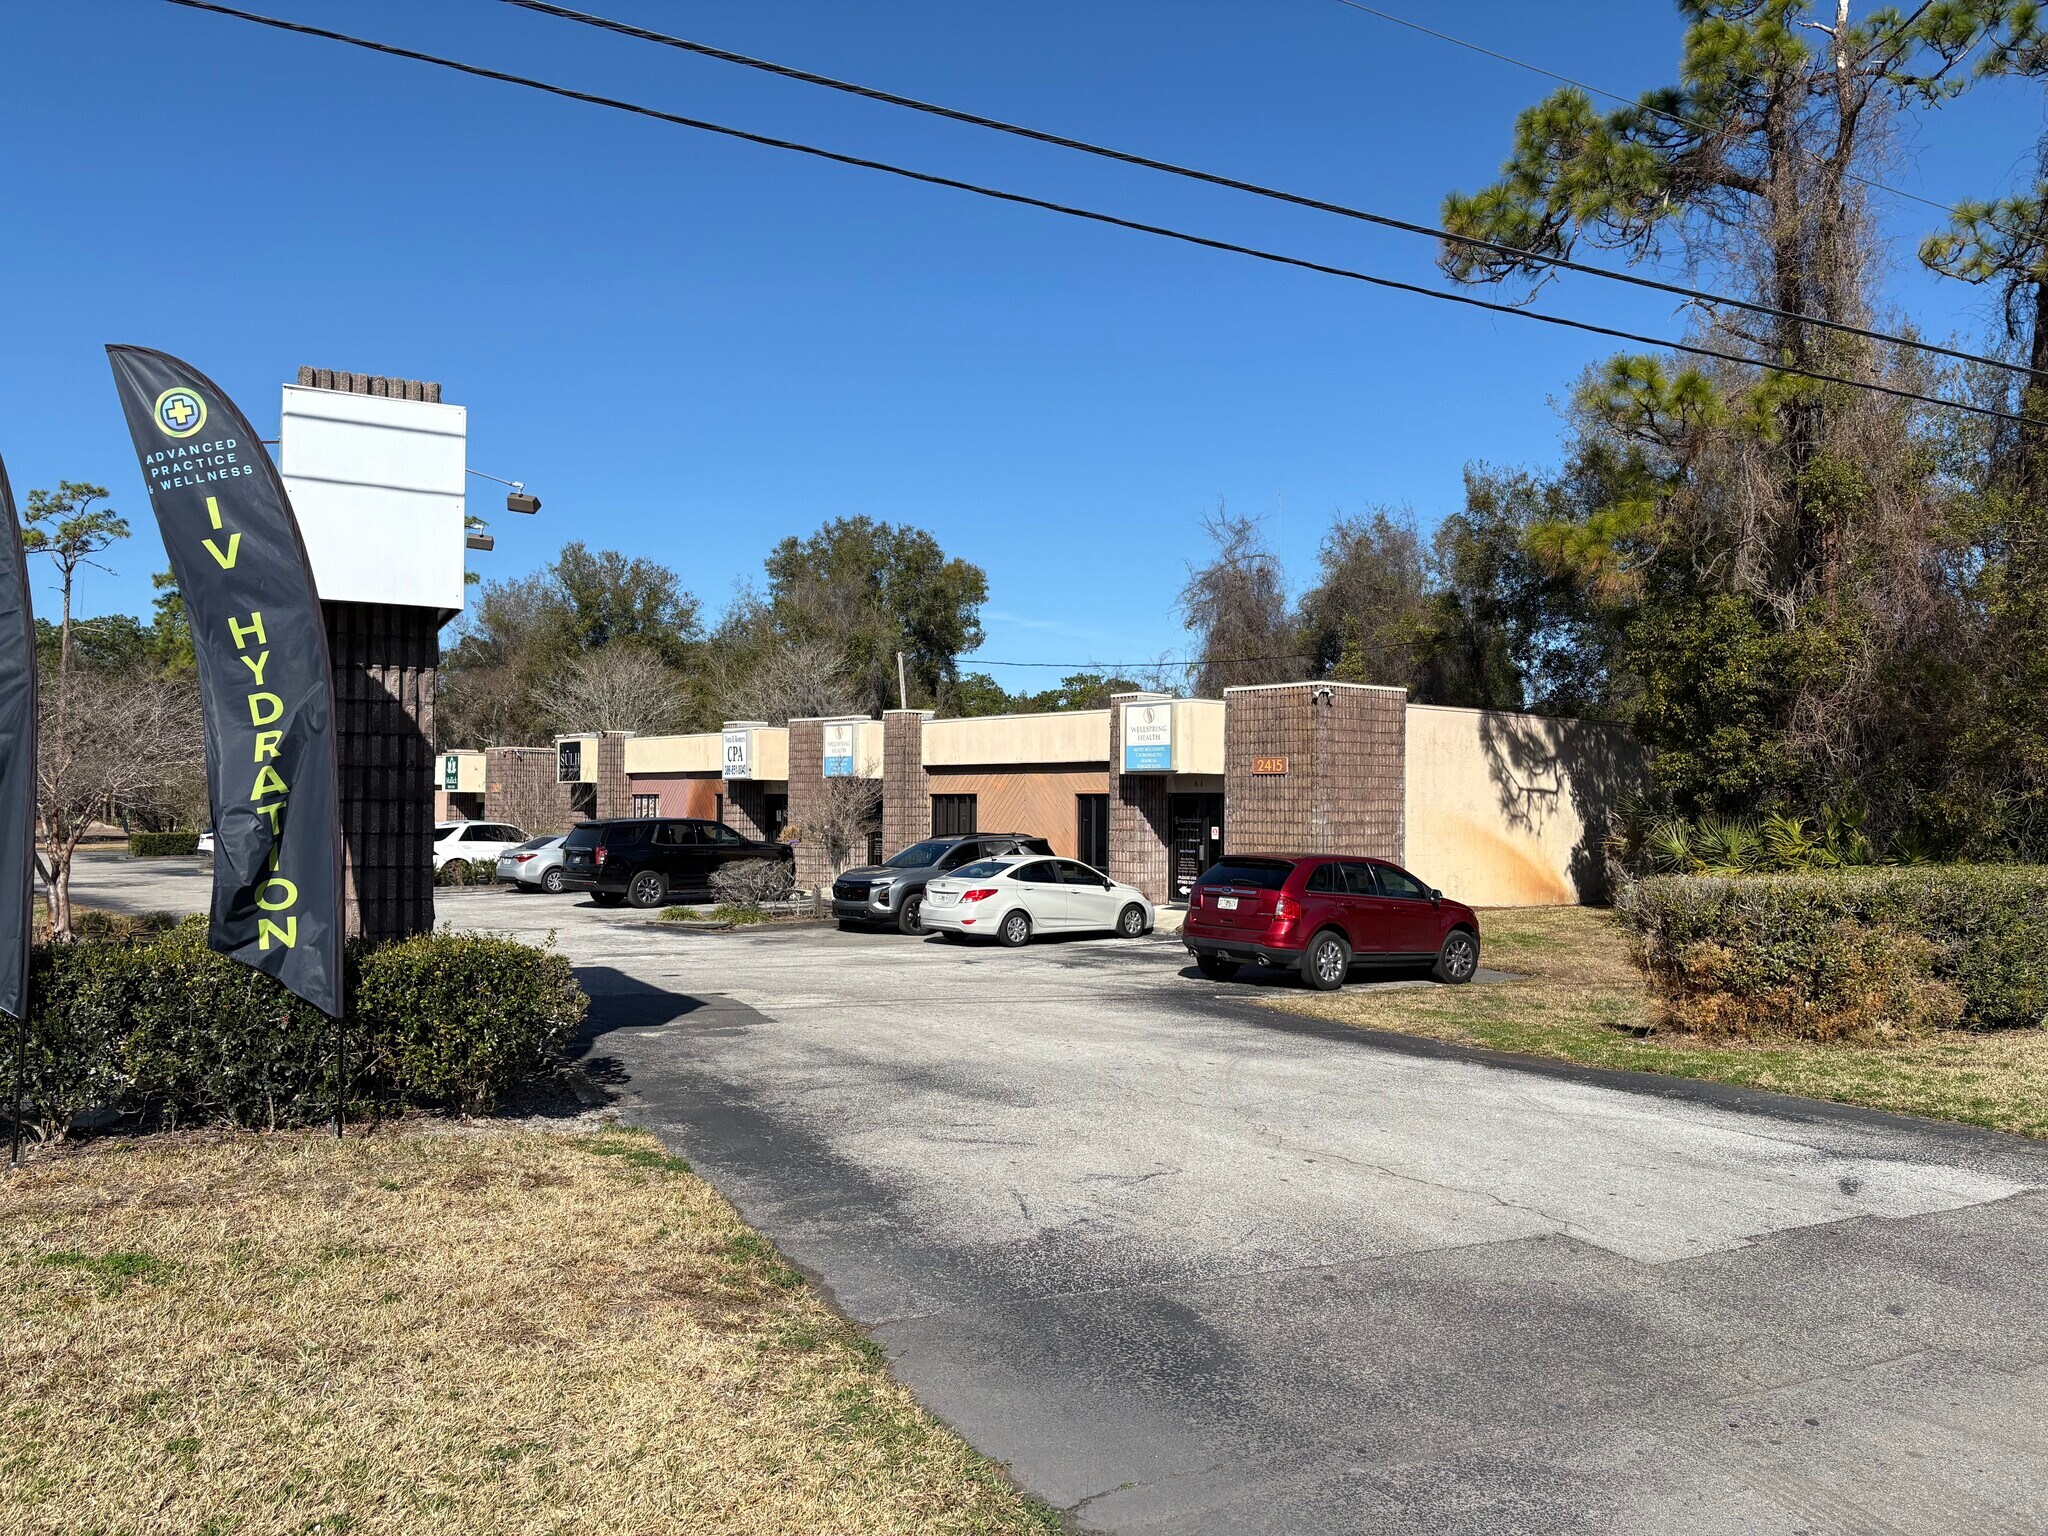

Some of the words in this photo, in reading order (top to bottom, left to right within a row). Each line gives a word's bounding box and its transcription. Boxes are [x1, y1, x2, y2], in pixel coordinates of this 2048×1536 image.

[146, 439, 237, 465] ADVANCED
[151, 453, 237, 478] PRACTICE
[160, 465, 253, 491] WELLNESS
[201, 496, 241, 569] IV
[1131, 725, 1167, 733] WELLSPRING
[727, 746, 743, 762] CPA
[1257, 759, 1283, 772] 2415
[228, 611, 298, 951] HYDRATION
